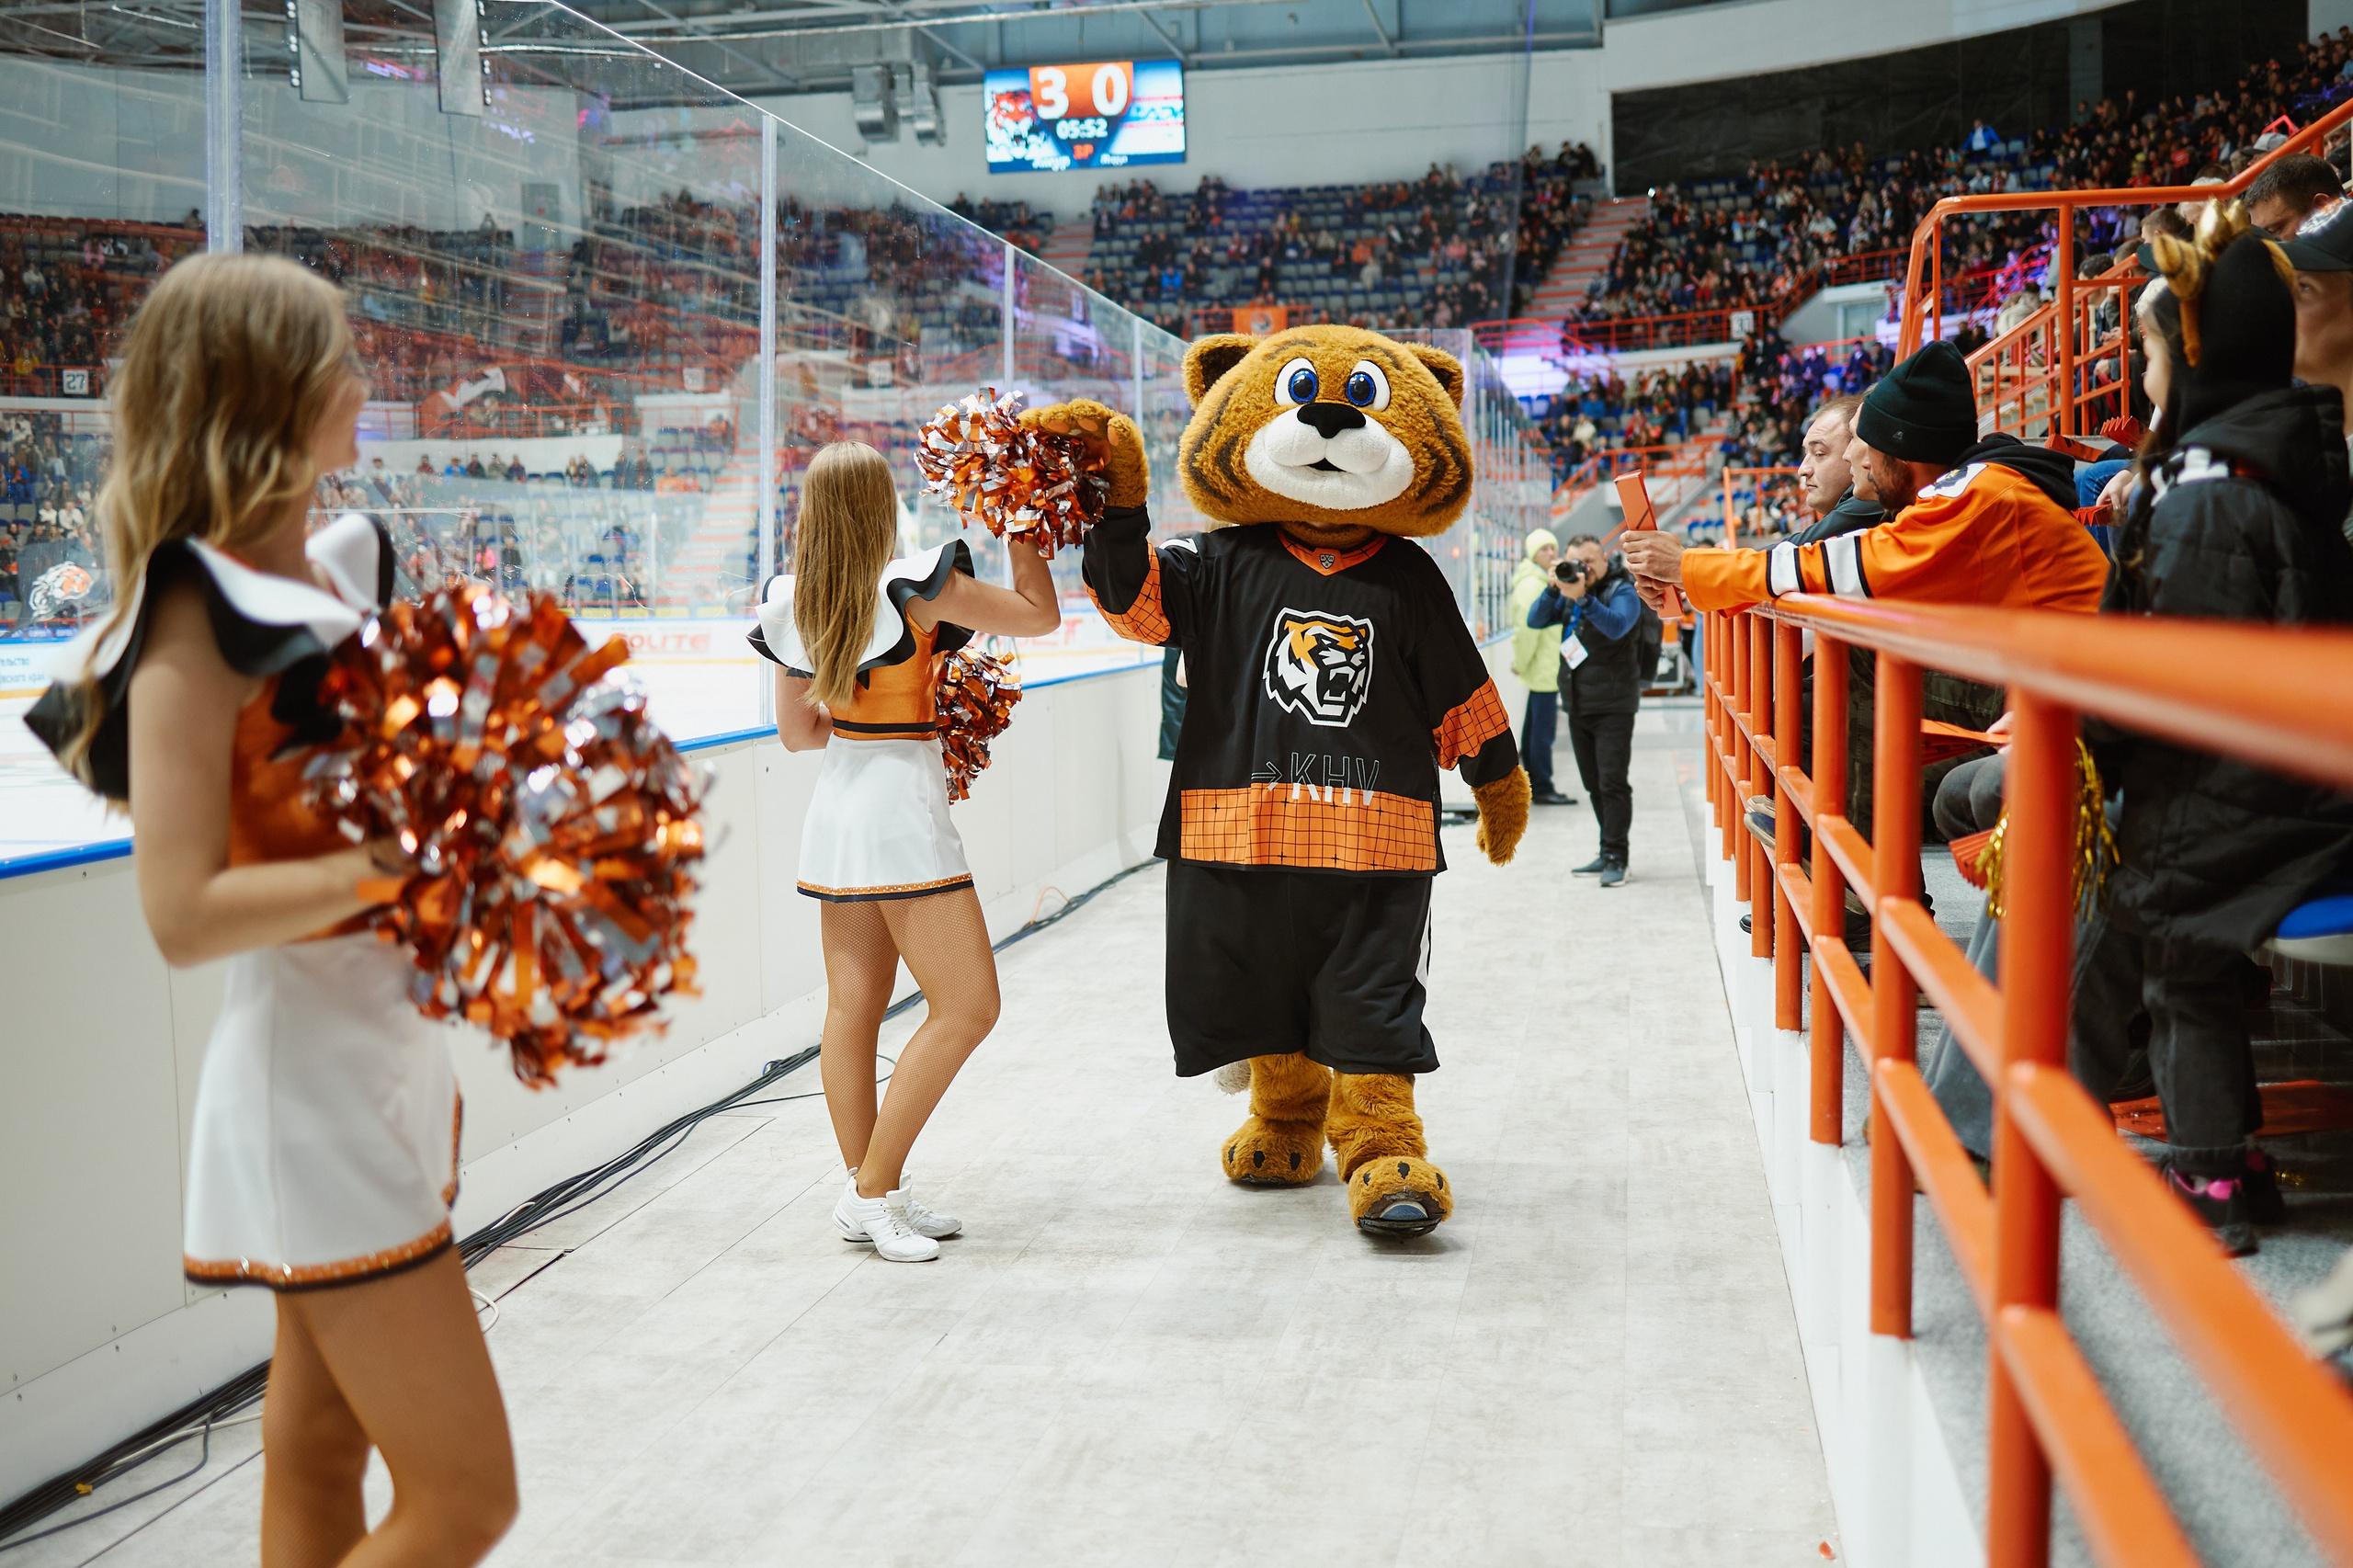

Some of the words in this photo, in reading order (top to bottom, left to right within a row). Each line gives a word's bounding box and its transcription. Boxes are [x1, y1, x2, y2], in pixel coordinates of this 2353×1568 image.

[1037, 67, 1070, 120] 3
[1091, 64, 1129, 117] 0
[1056, 117, 1108, 140] 05:52
[66, 373, 85, 391] 27
[1290, 752, 1380, 806] KHV
